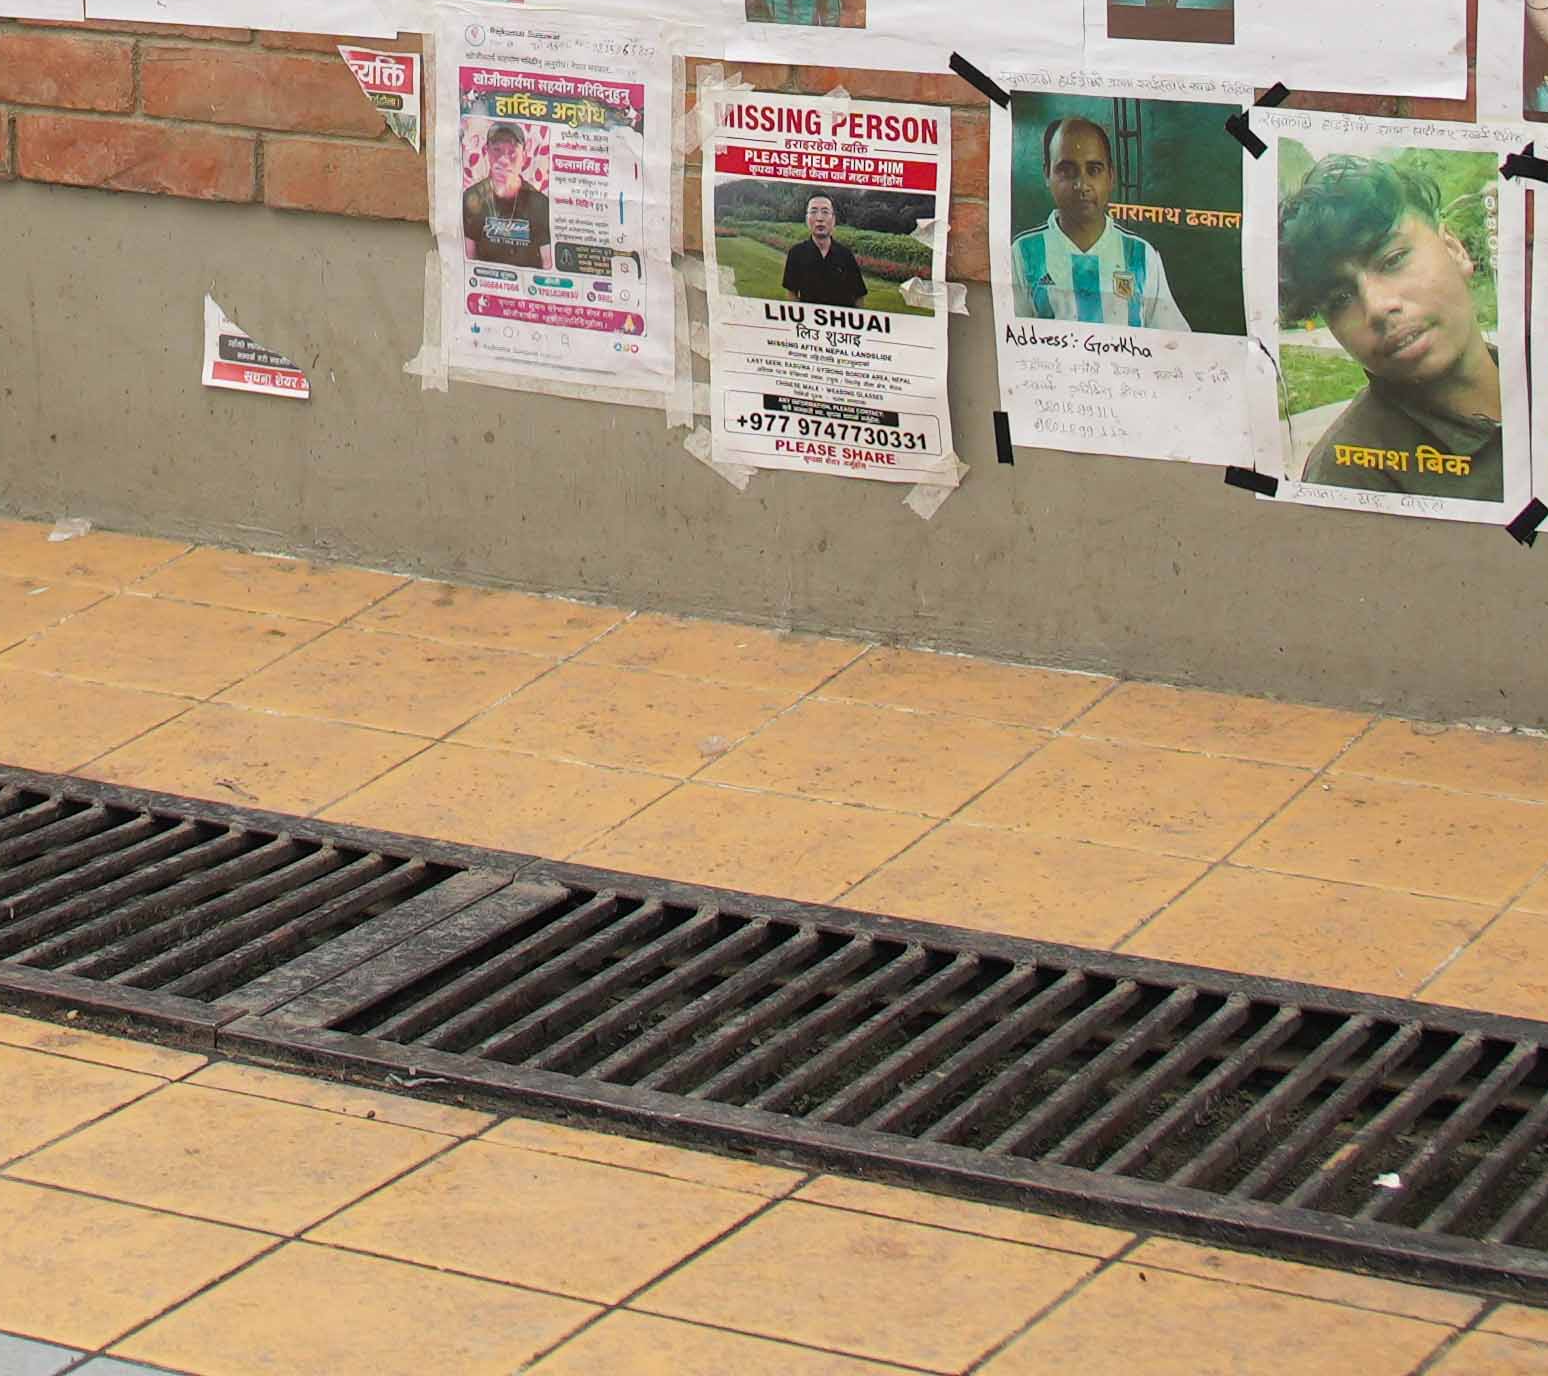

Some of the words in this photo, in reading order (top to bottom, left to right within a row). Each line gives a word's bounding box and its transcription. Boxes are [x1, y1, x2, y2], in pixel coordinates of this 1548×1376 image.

[714, 103, 822, 136] MISSING
[832, 112, 938, 145] PERSON
[745, 150, 798, 166] PLEASE
[802, 154, 838, 169] HELP
[842, 158, 875, 172] FIND
[878, 161, 903, 175] HIM
[765, 304, 805, 323] LIU
[814, 308, 891, 334] SHUAI
[767, 339, 799, 350] MISSING
[801, 344, 822, 354] AFTER
[824, 347, 849, 357] NEPAL
[851, 350, 892, 362] LANDSLIDE
[1084, 334, 1154, 360] Gorkha
[736, 412, 790, 434] +977
[798, 418, 927, 450] 9747730331
[1334, 442, 1408, 477] प्रकाश
